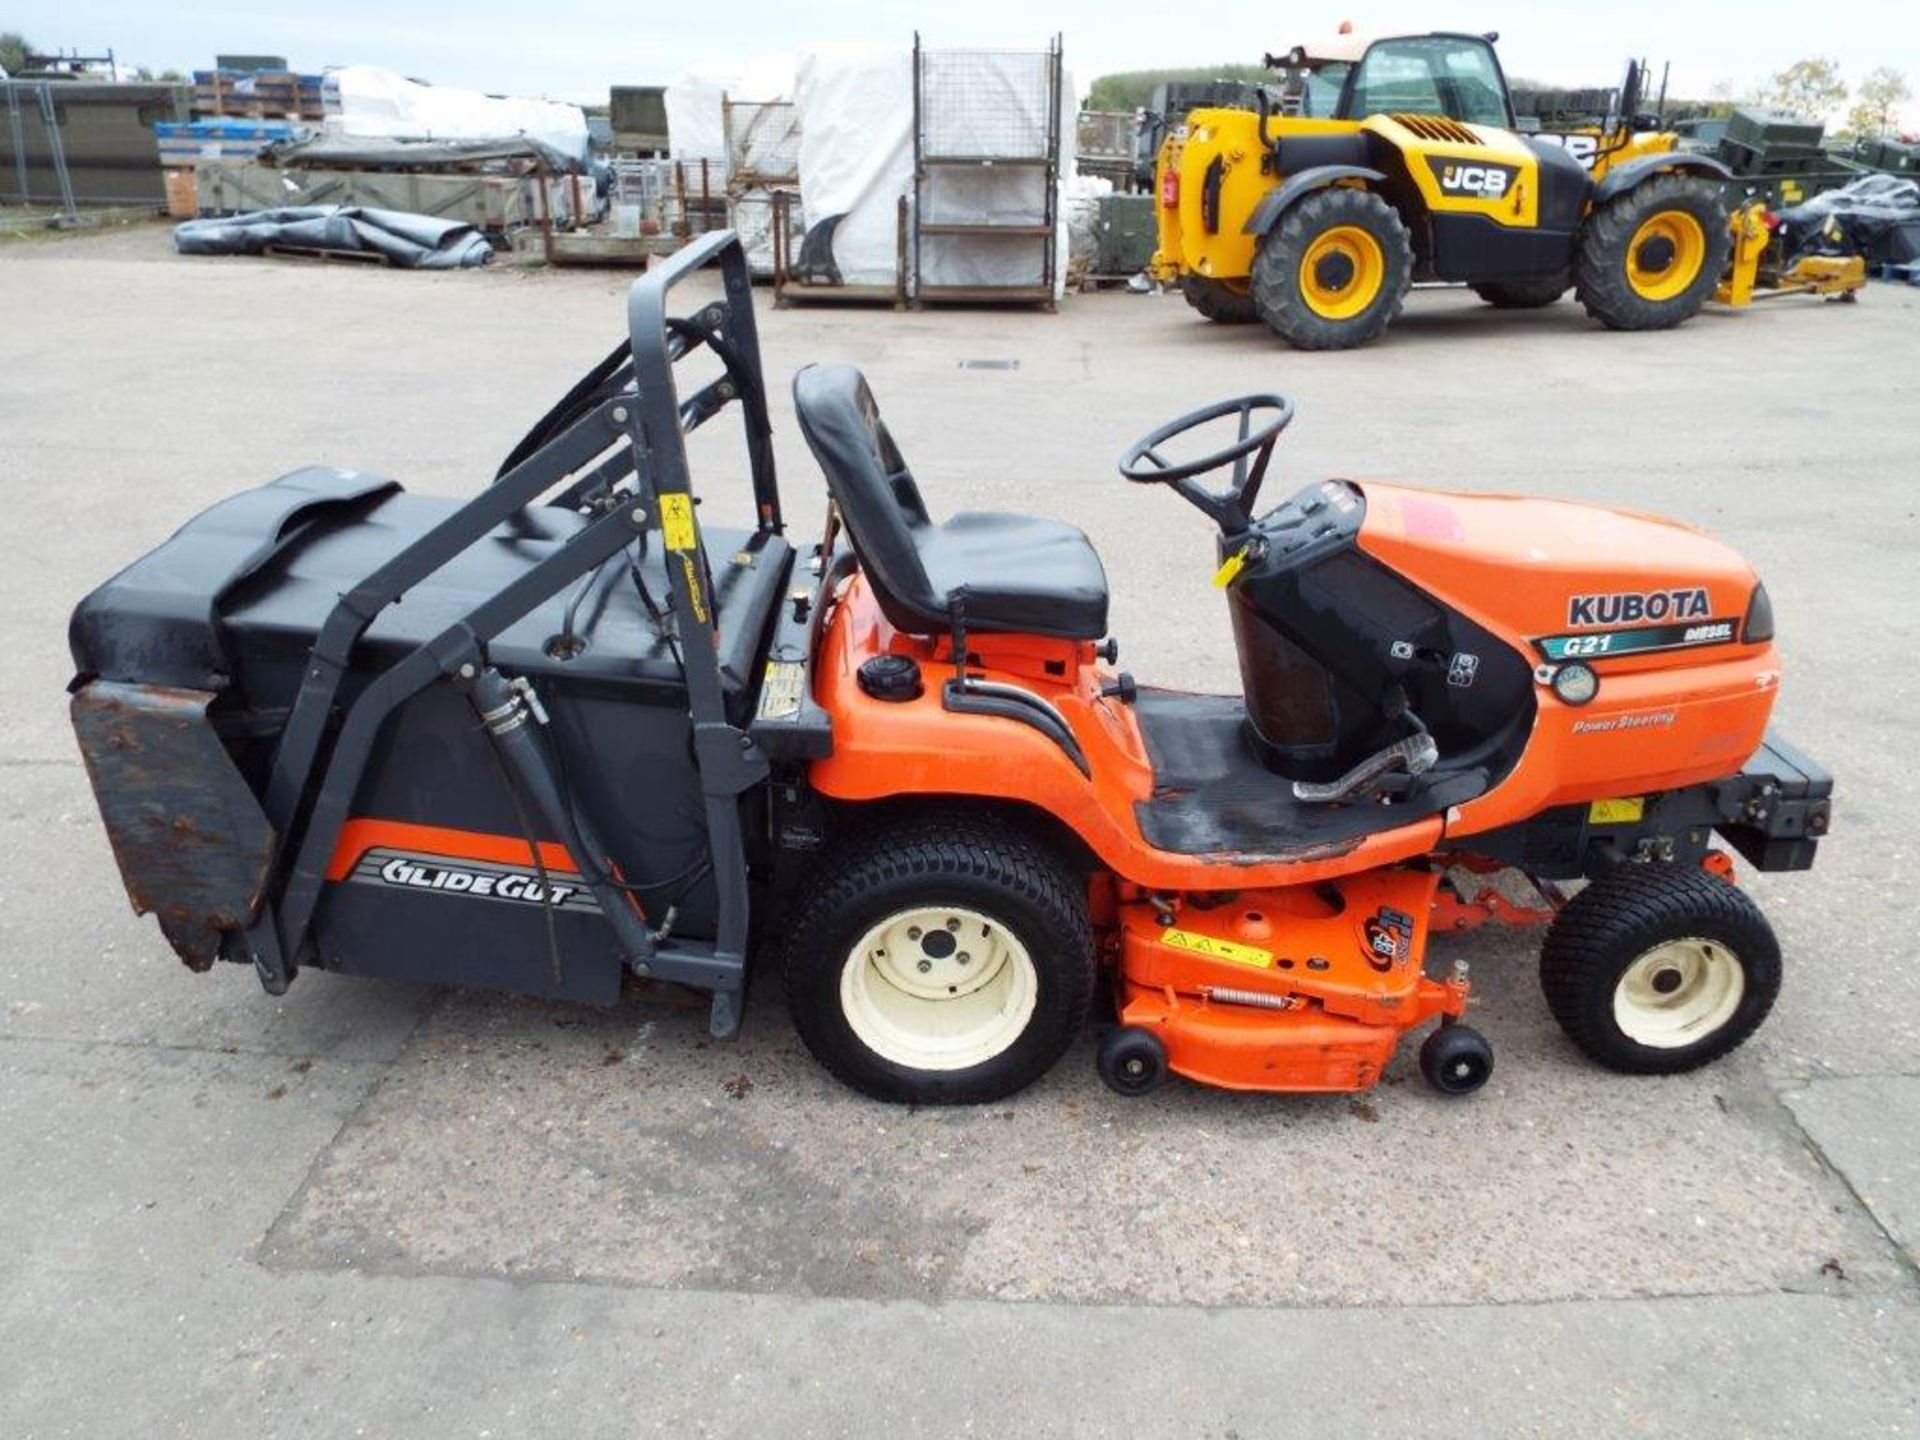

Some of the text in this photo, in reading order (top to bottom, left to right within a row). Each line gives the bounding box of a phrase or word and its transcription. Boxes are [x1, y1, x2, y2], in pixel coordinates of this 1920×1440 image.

[1443, 166, 1507, 192] JCB
[1569, 589, 1710, 625] KUBOTA
[1563, 624, 1731, 655] G21 DIESEL
